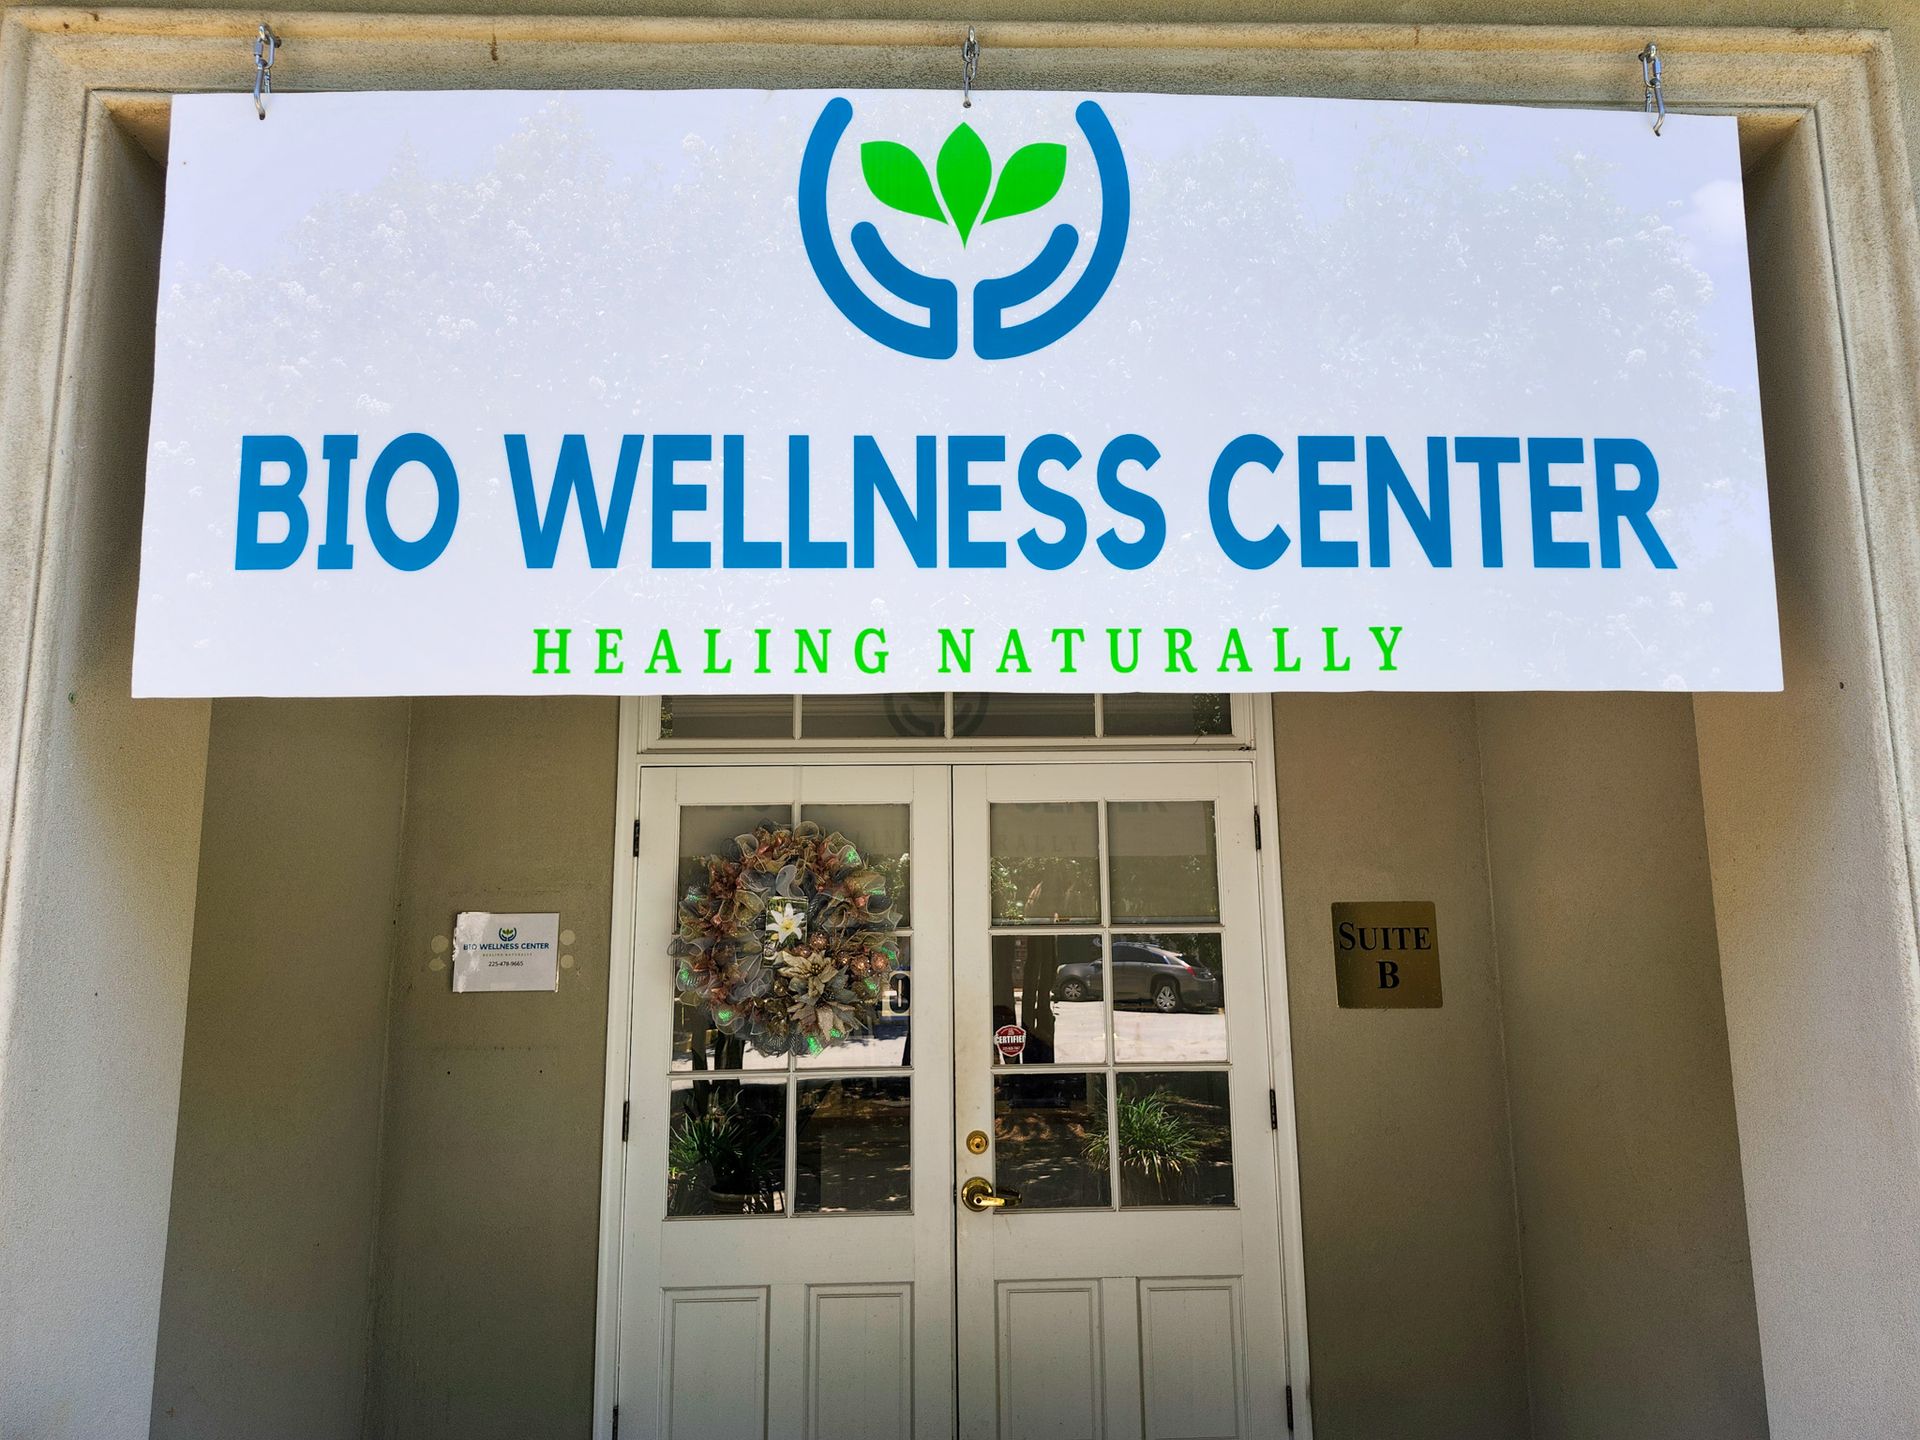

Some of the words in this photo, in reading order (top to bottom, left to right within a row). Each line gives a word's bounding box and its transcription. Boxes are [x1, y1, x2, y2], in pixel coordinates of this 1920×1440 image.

[235, 433, 460, 571] BIO
[504, 433, 1166, 571] WELLNESS
[1208, 433, 1677, 571] CENTER
[532, 627, 889, 675] HEALING
[938, 626, 1403, 674] NATURALLY
[521, 942, 549, 950] CENTER
[1338, 921, 1432, 951] SUITE
[1375, 960, 1400, 989] B
